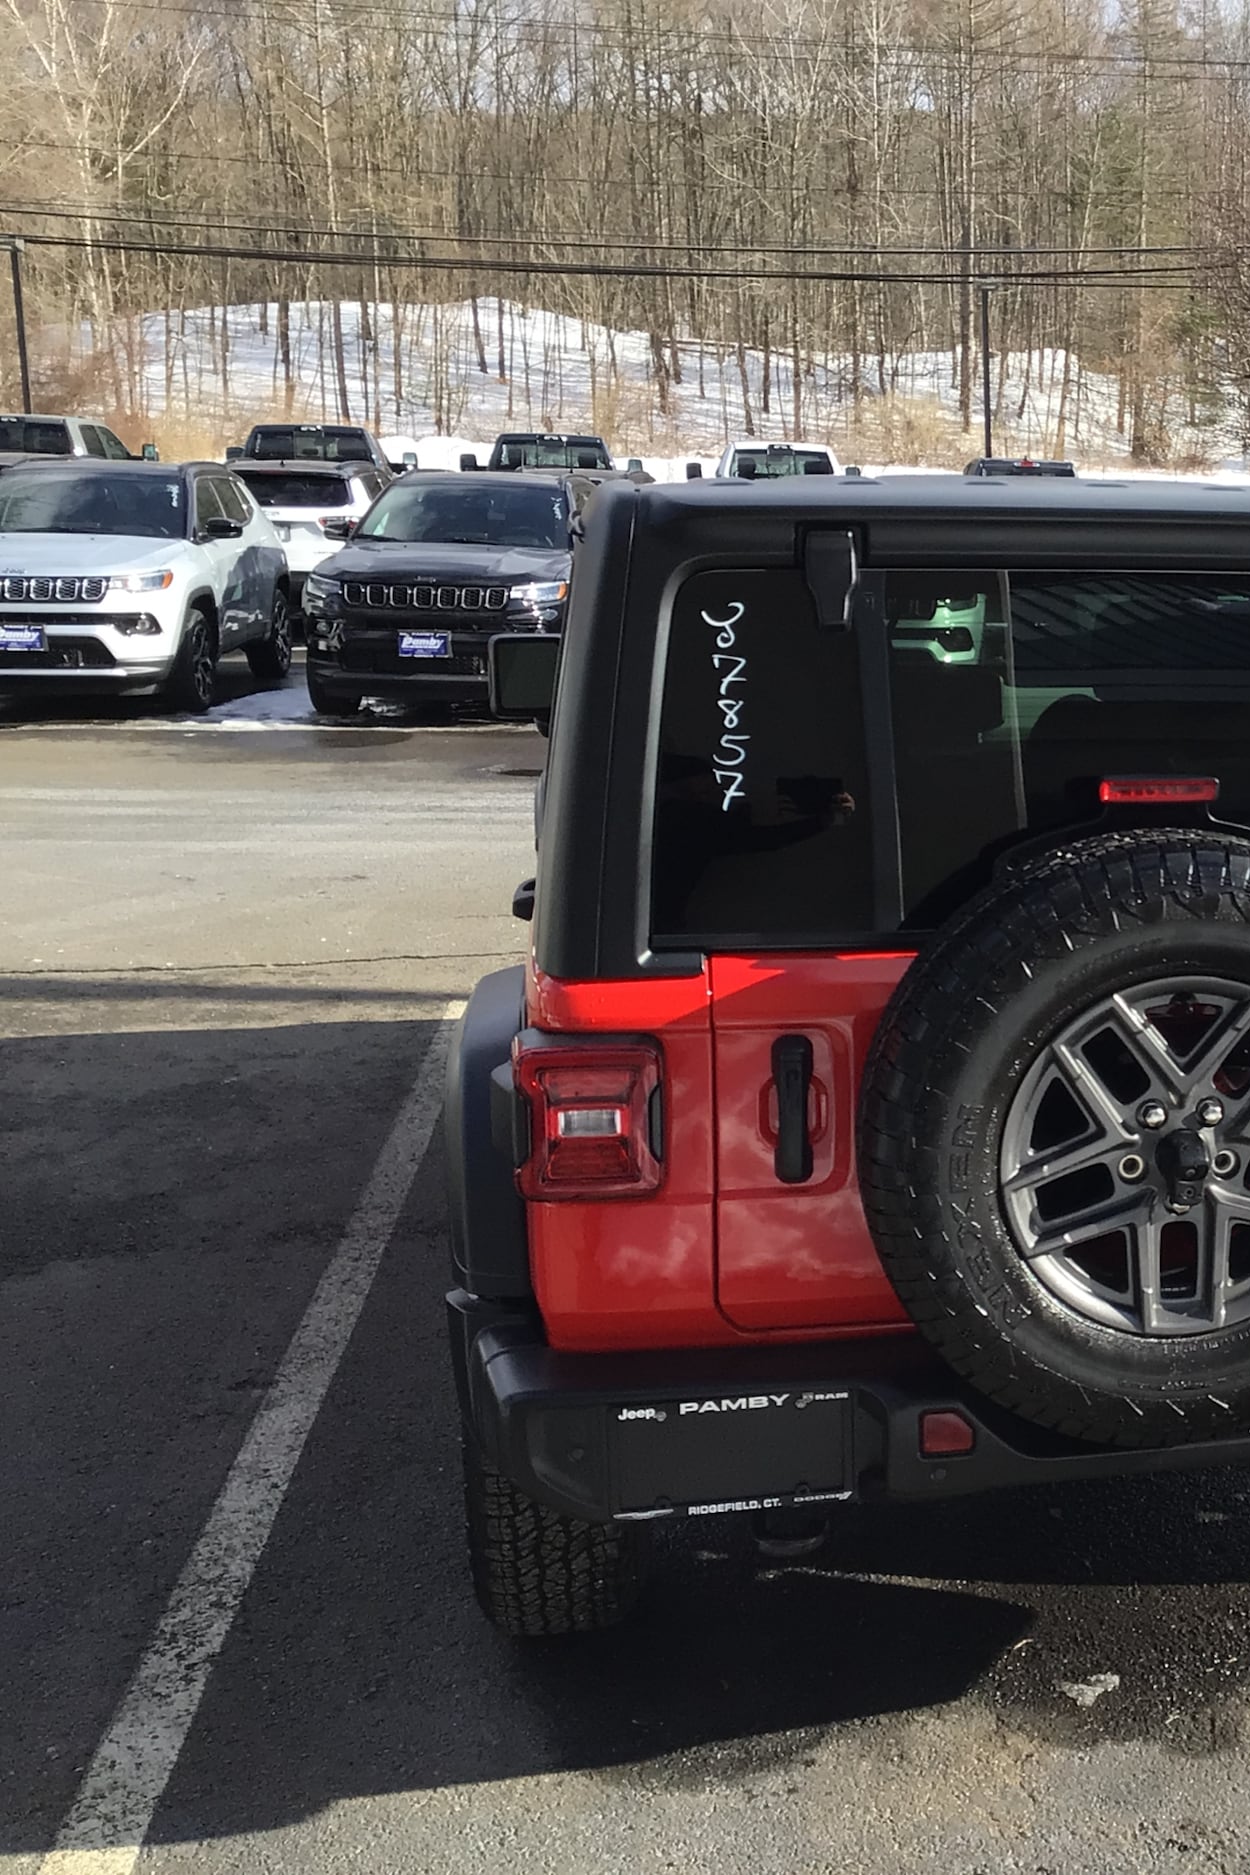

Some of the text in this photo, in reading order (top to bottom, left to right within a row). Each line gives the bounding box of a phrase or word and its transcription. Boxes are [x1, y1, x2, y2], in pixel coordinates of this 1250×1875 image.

[401, 635, 445, 649] Pamby
[949, 1103, 1032, 1330] NEXEN
[617, 1391, 849, 1421] Jeep PAMBY RAM
